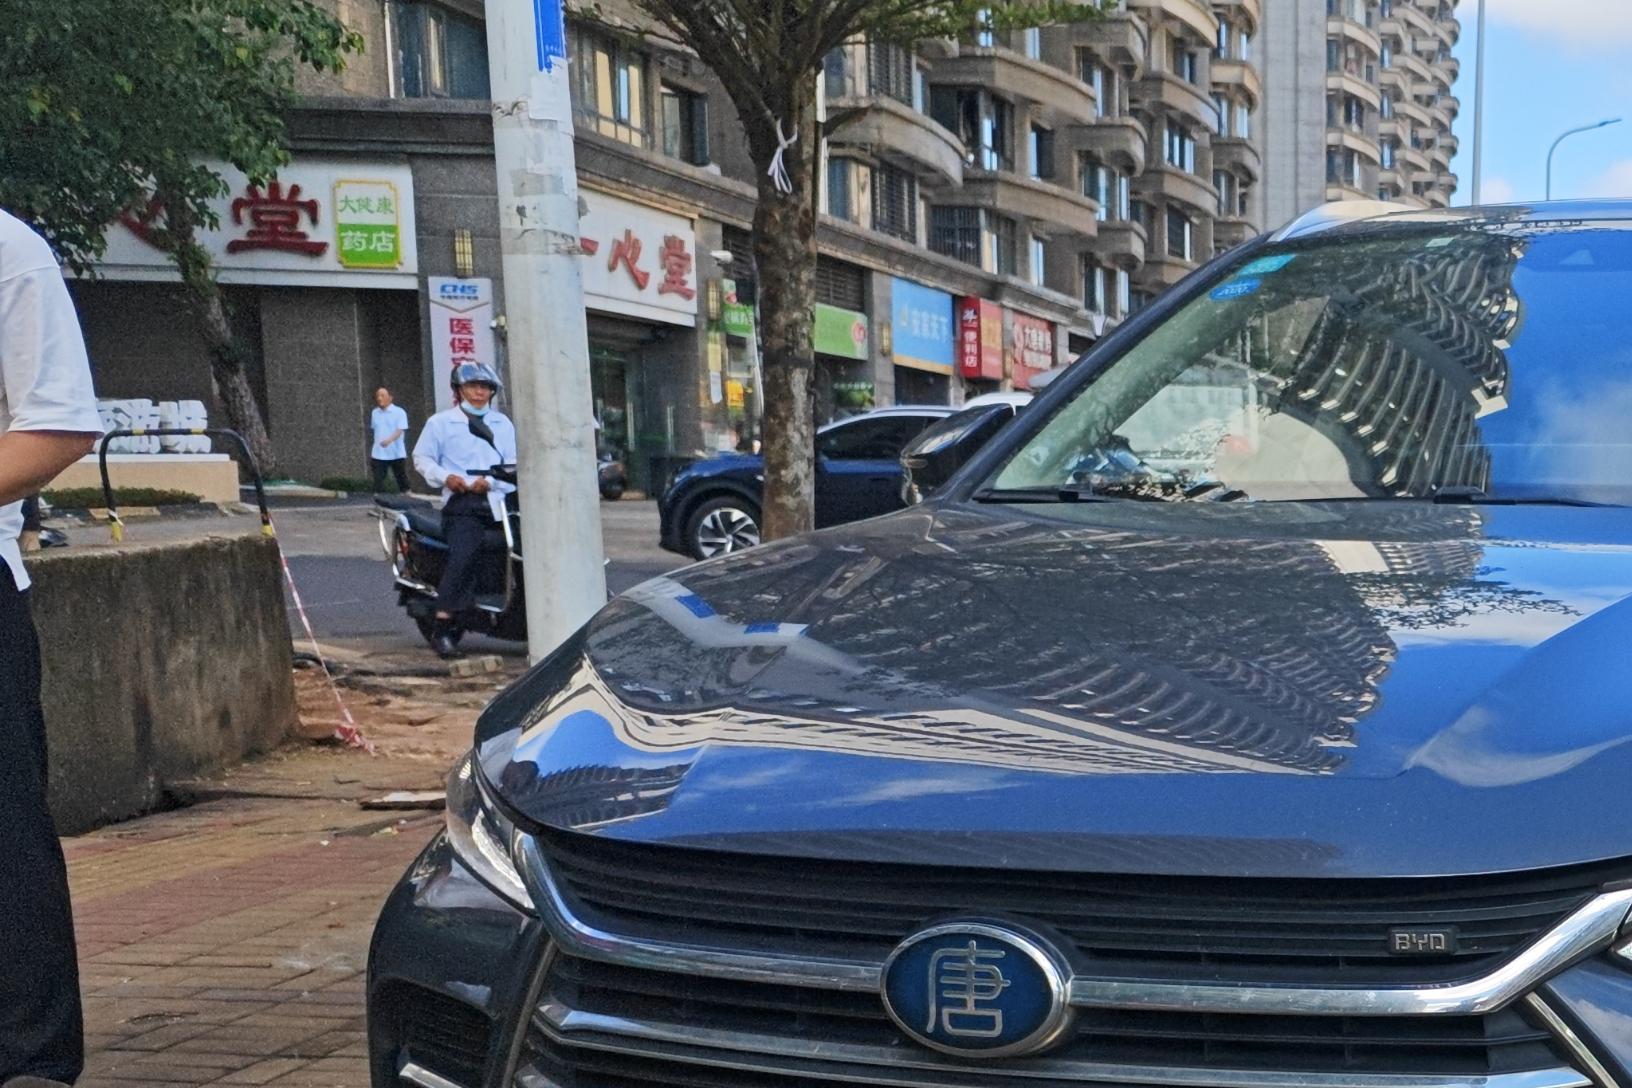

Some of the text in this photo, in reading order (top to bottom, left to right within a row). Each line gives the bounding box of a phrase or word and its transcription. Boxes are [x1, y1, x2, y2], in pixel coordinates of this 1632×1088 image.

[339, 194, 395, 215] 大健康
[340, 229, 395, 254] 药店
[963, 330, 978, 368] 便利店
[1394, 933, 1445, 951] BYD
